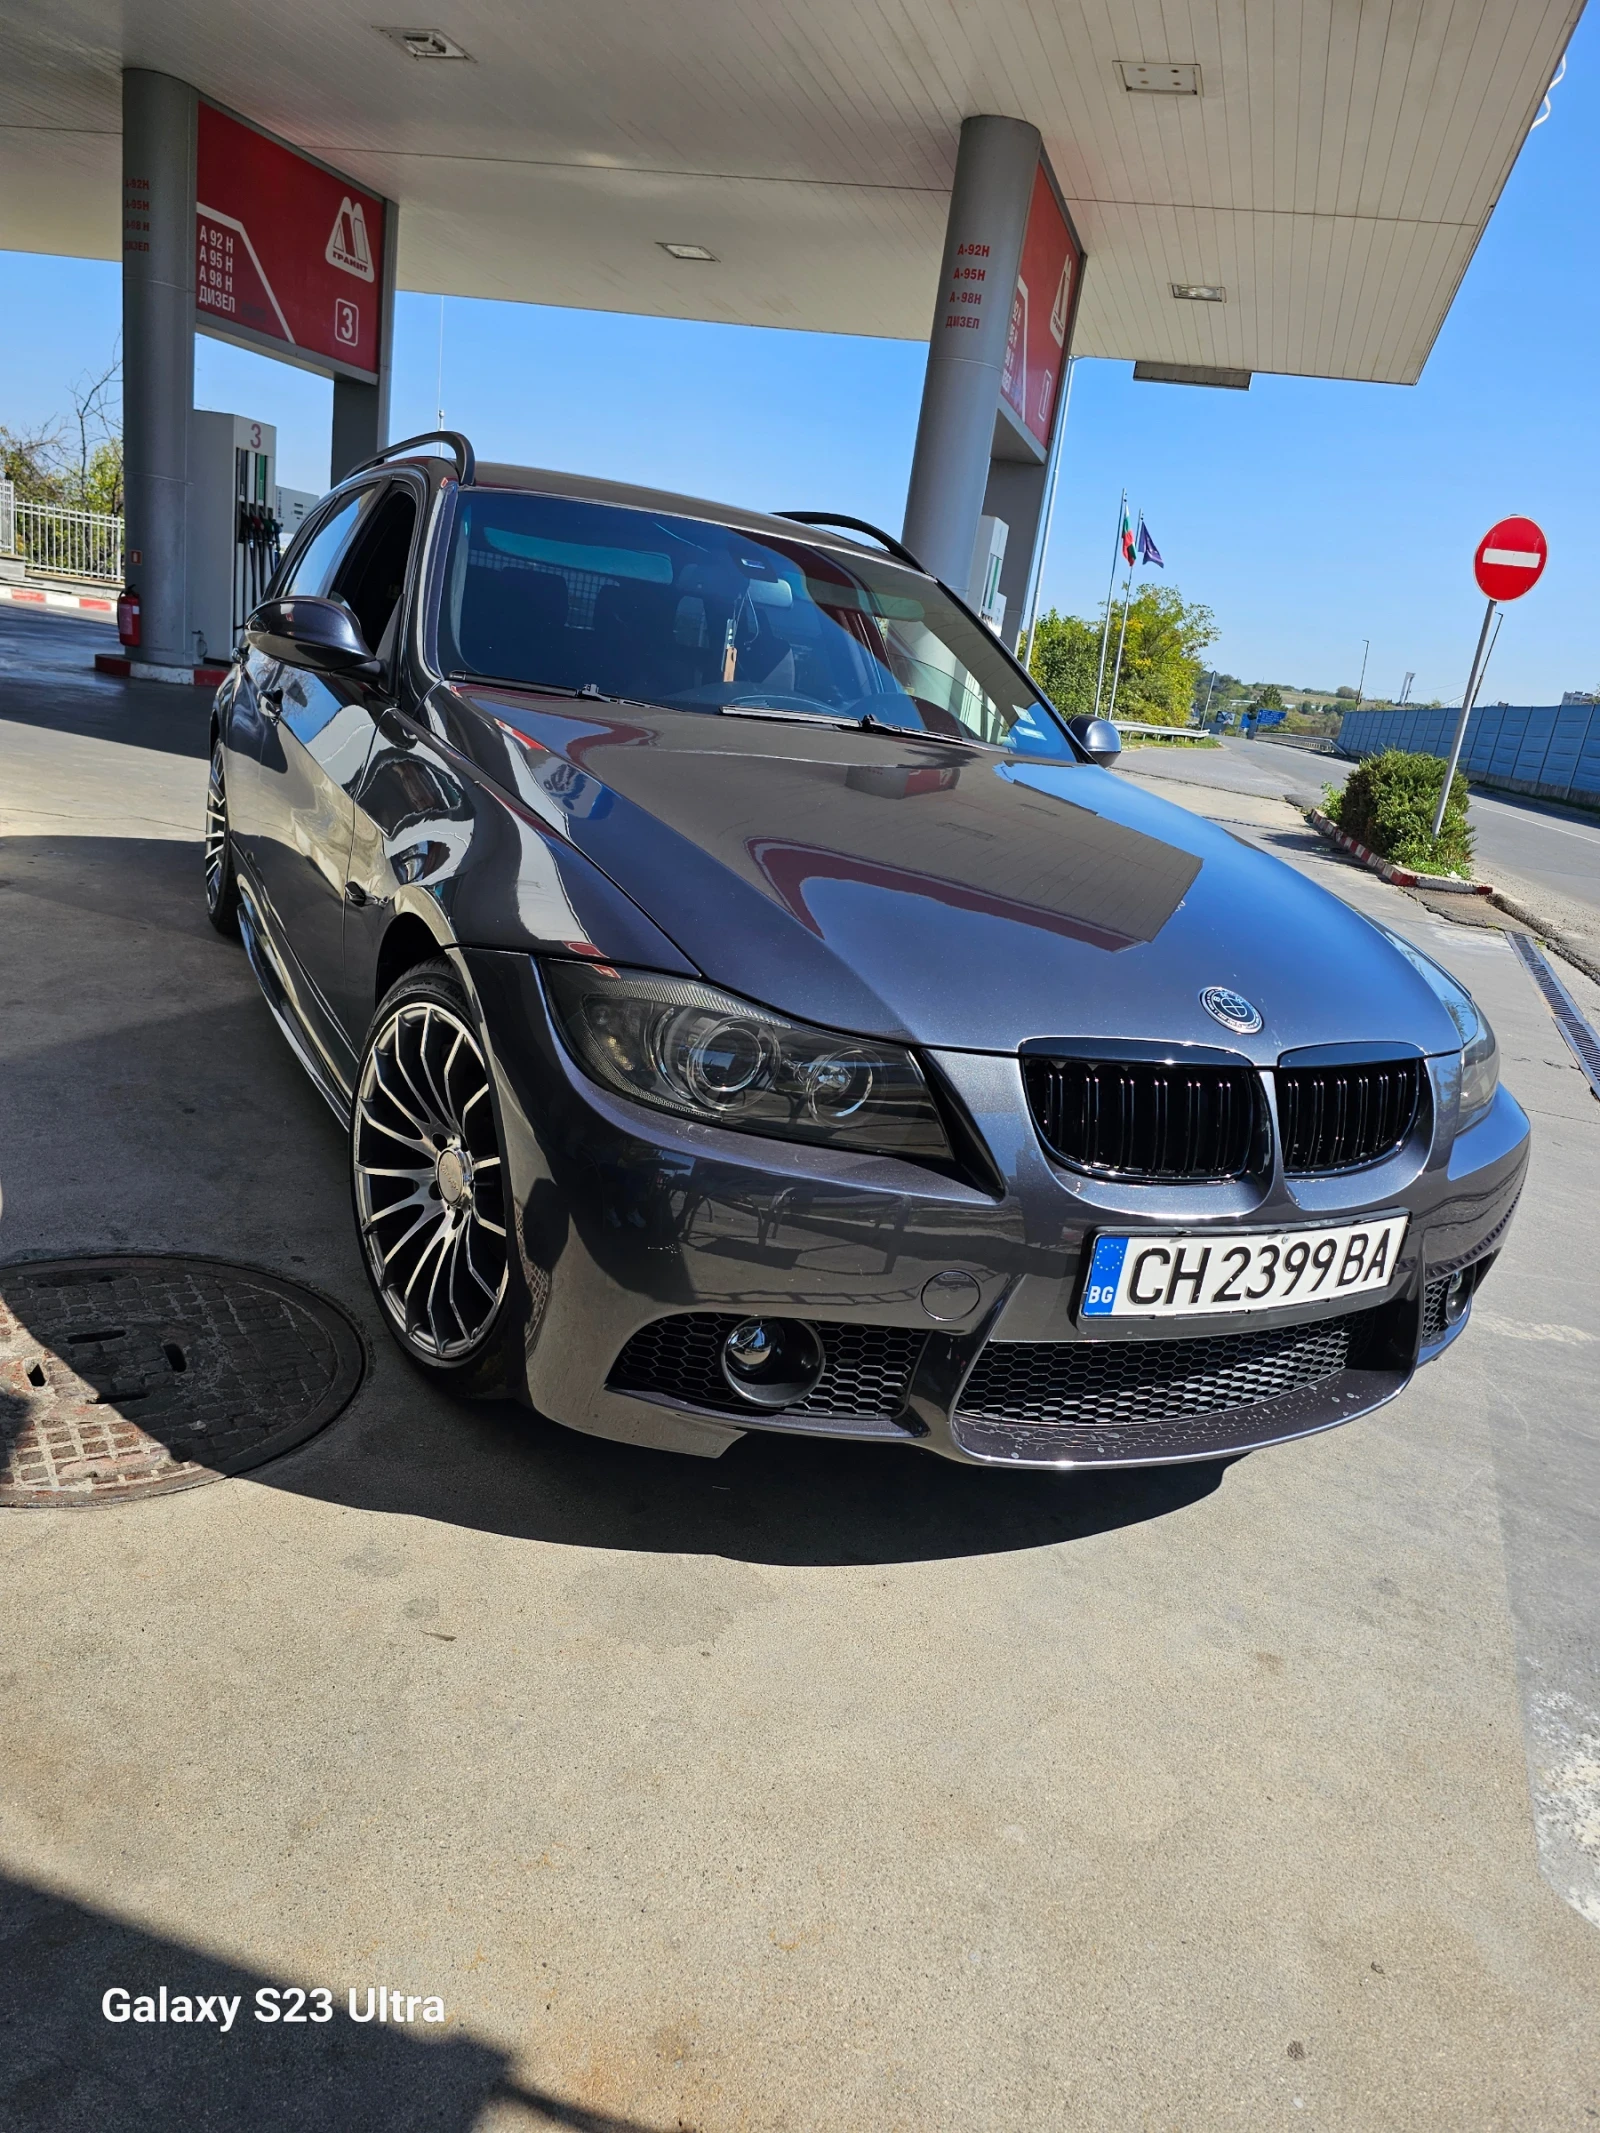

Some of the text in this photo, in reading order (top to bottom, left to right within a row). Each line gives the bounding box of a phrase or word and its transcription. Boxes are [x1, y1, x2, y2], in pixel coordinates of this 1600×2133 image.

[199, 225, 234, 254] А 92 Н
[199, 246, 233, 274] А 95 Н
[198, 266, 233, 293] А 98 Н
[198, 285, 236, 313] ДИЗЕЛ
[341, 307, 353, 340] 3
[945, 315, 980, 329] ДИЗЕЛ
[250, 423, 261, 449] 3
[1088, 1285, 1114, 1304] BG
